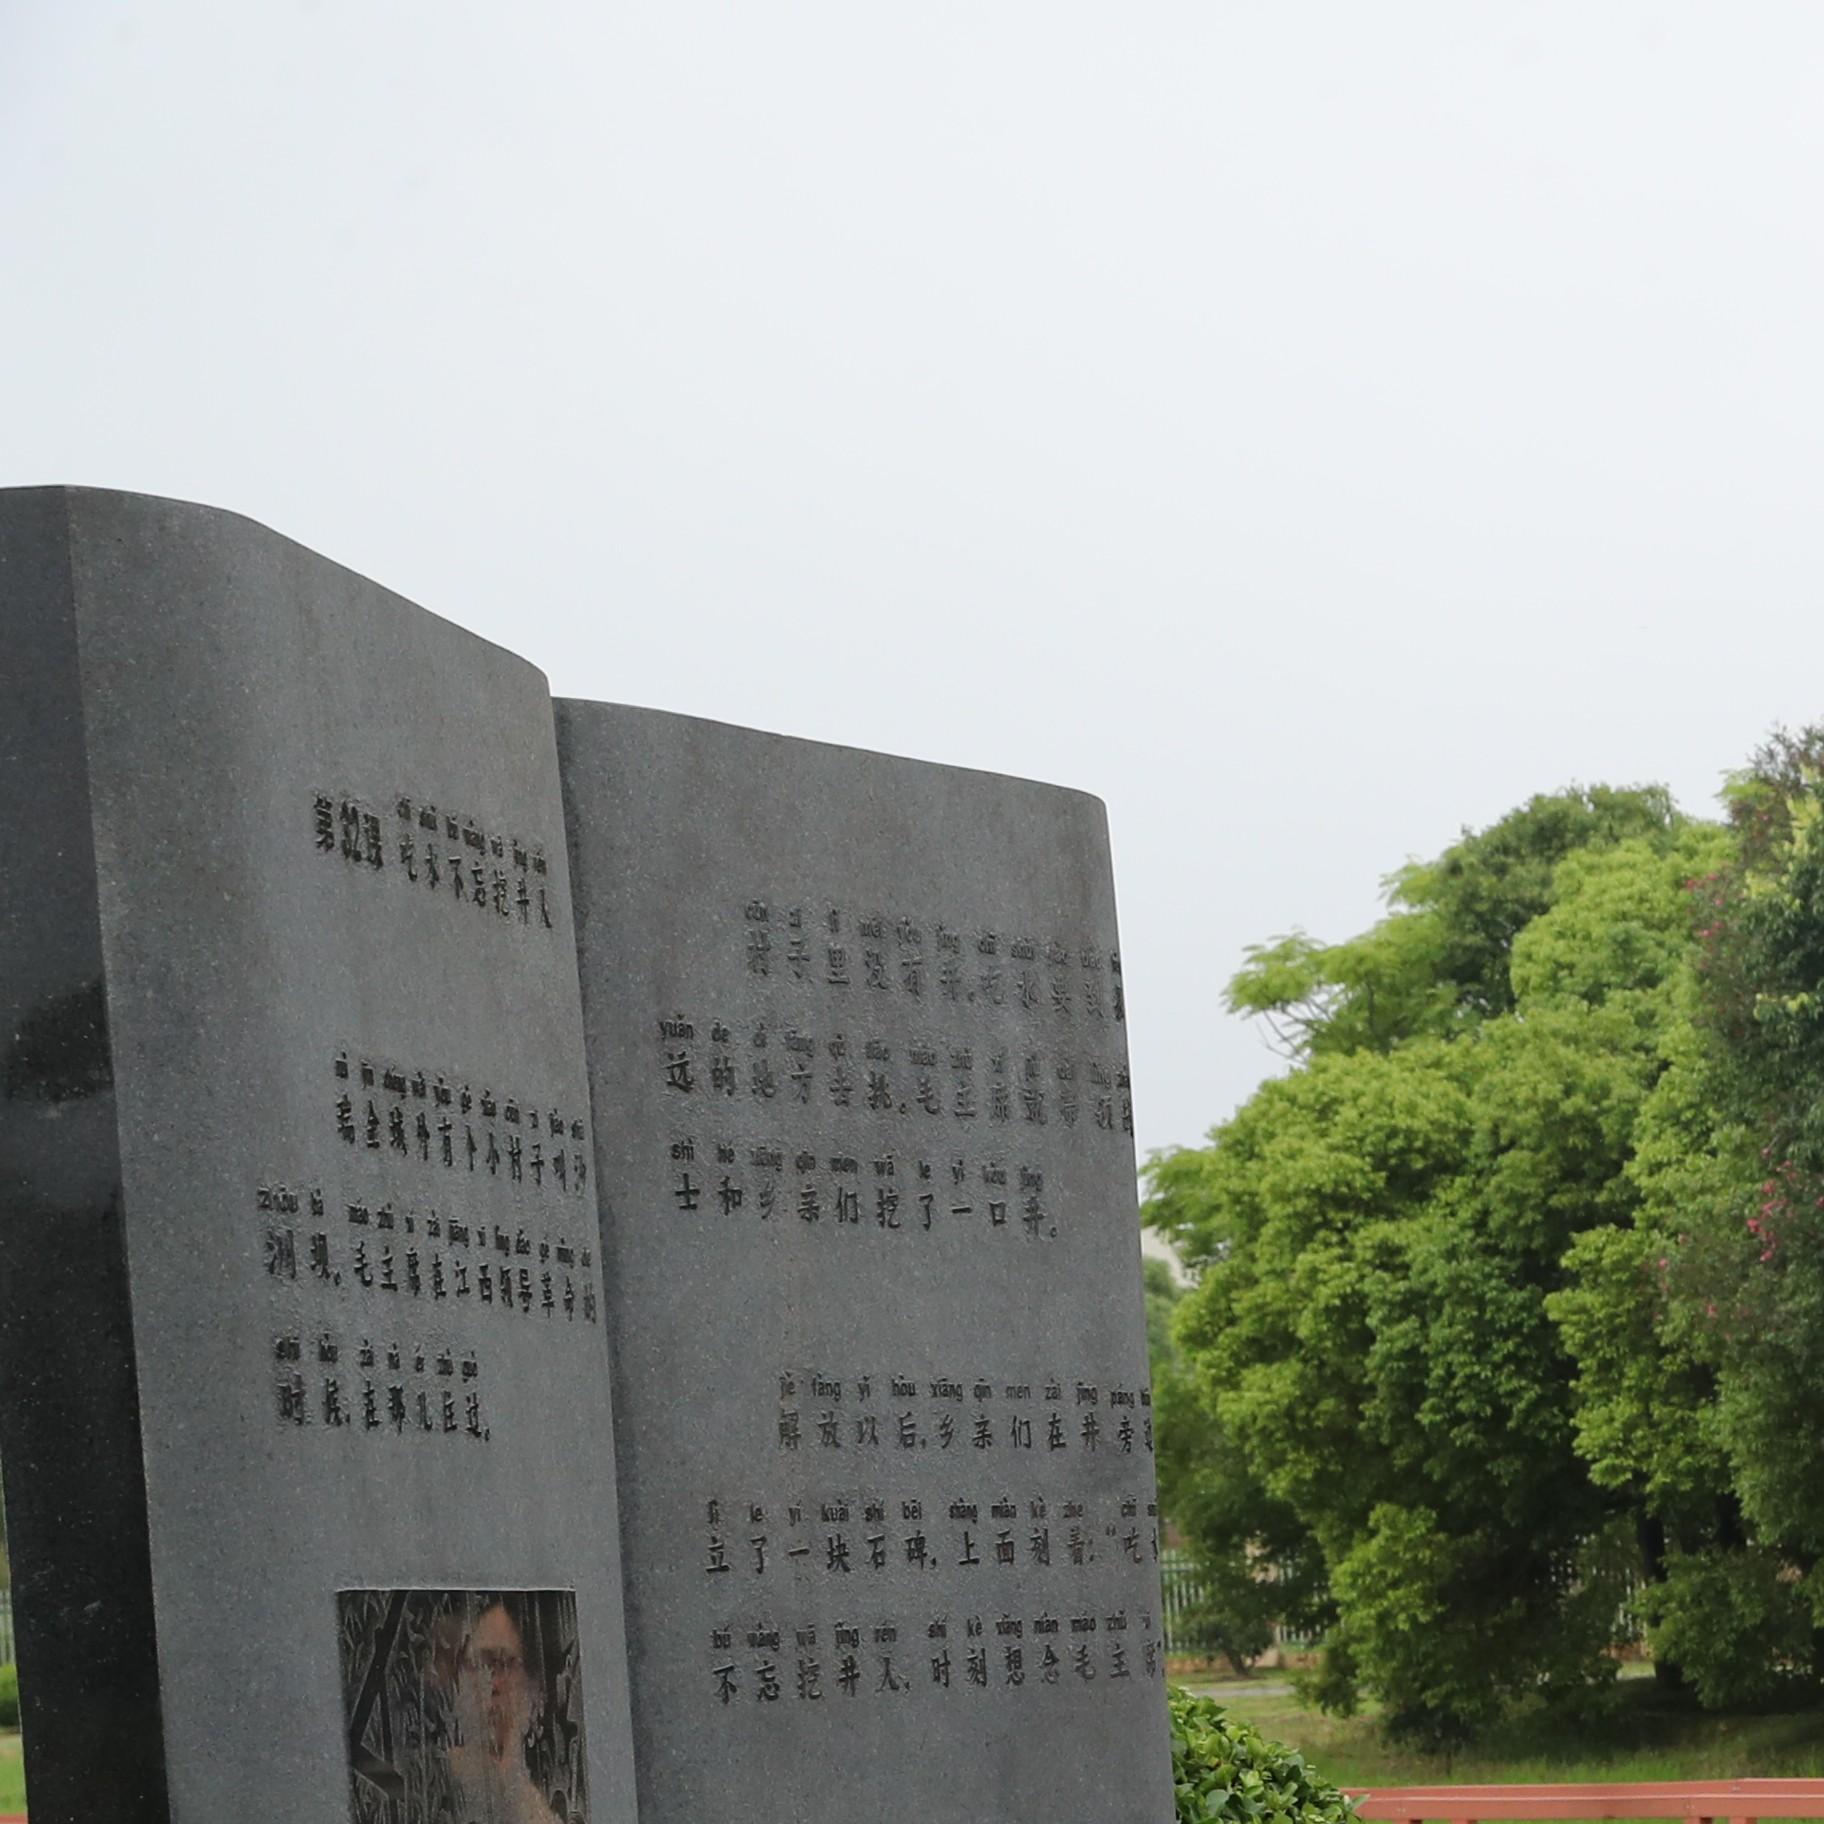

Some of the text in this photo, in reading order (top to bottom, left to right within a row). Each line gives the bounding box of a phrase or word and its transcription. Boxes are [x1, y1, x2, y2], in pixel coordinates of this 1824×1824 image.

[675, 1173, 1058, 1238] 士和乡亲们挖了一口井。
[891, 1373, 916, 1397] hòu
[930, 1377, 964, 1402] xiāng
[1005, 1383, 1031, 1400] men
[750, 1502, 763, 1523] le
[821, 1498, 849, 1522] kuài
[901, 1499, 922, 1521] bēi
